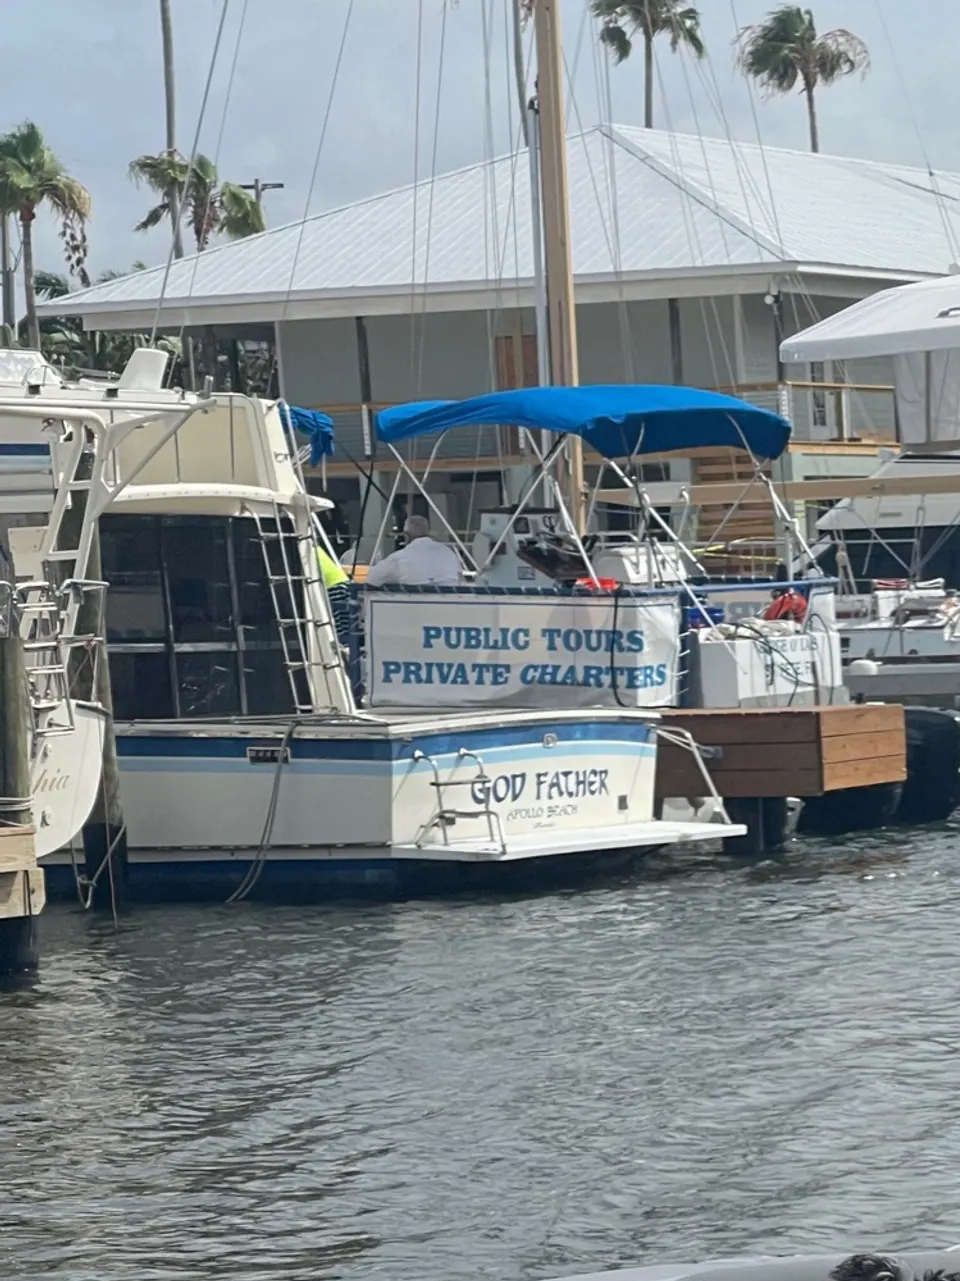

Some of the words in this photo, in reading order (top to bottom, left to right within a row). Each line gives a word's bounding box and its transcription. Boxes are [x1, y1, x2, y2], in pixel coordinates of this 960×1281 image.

[422, 626, 530, 651] PUBLIC
[541, 628, 645, 653] TOURS
[382, 661, 511, 686] PRIVATE
[520, 664, 666, 689] CHARTERS
[471, 772, 526, 804] GOD
[535, 769, 609, 800] FATHER
[507, 806, 544, 821] APOLLO
